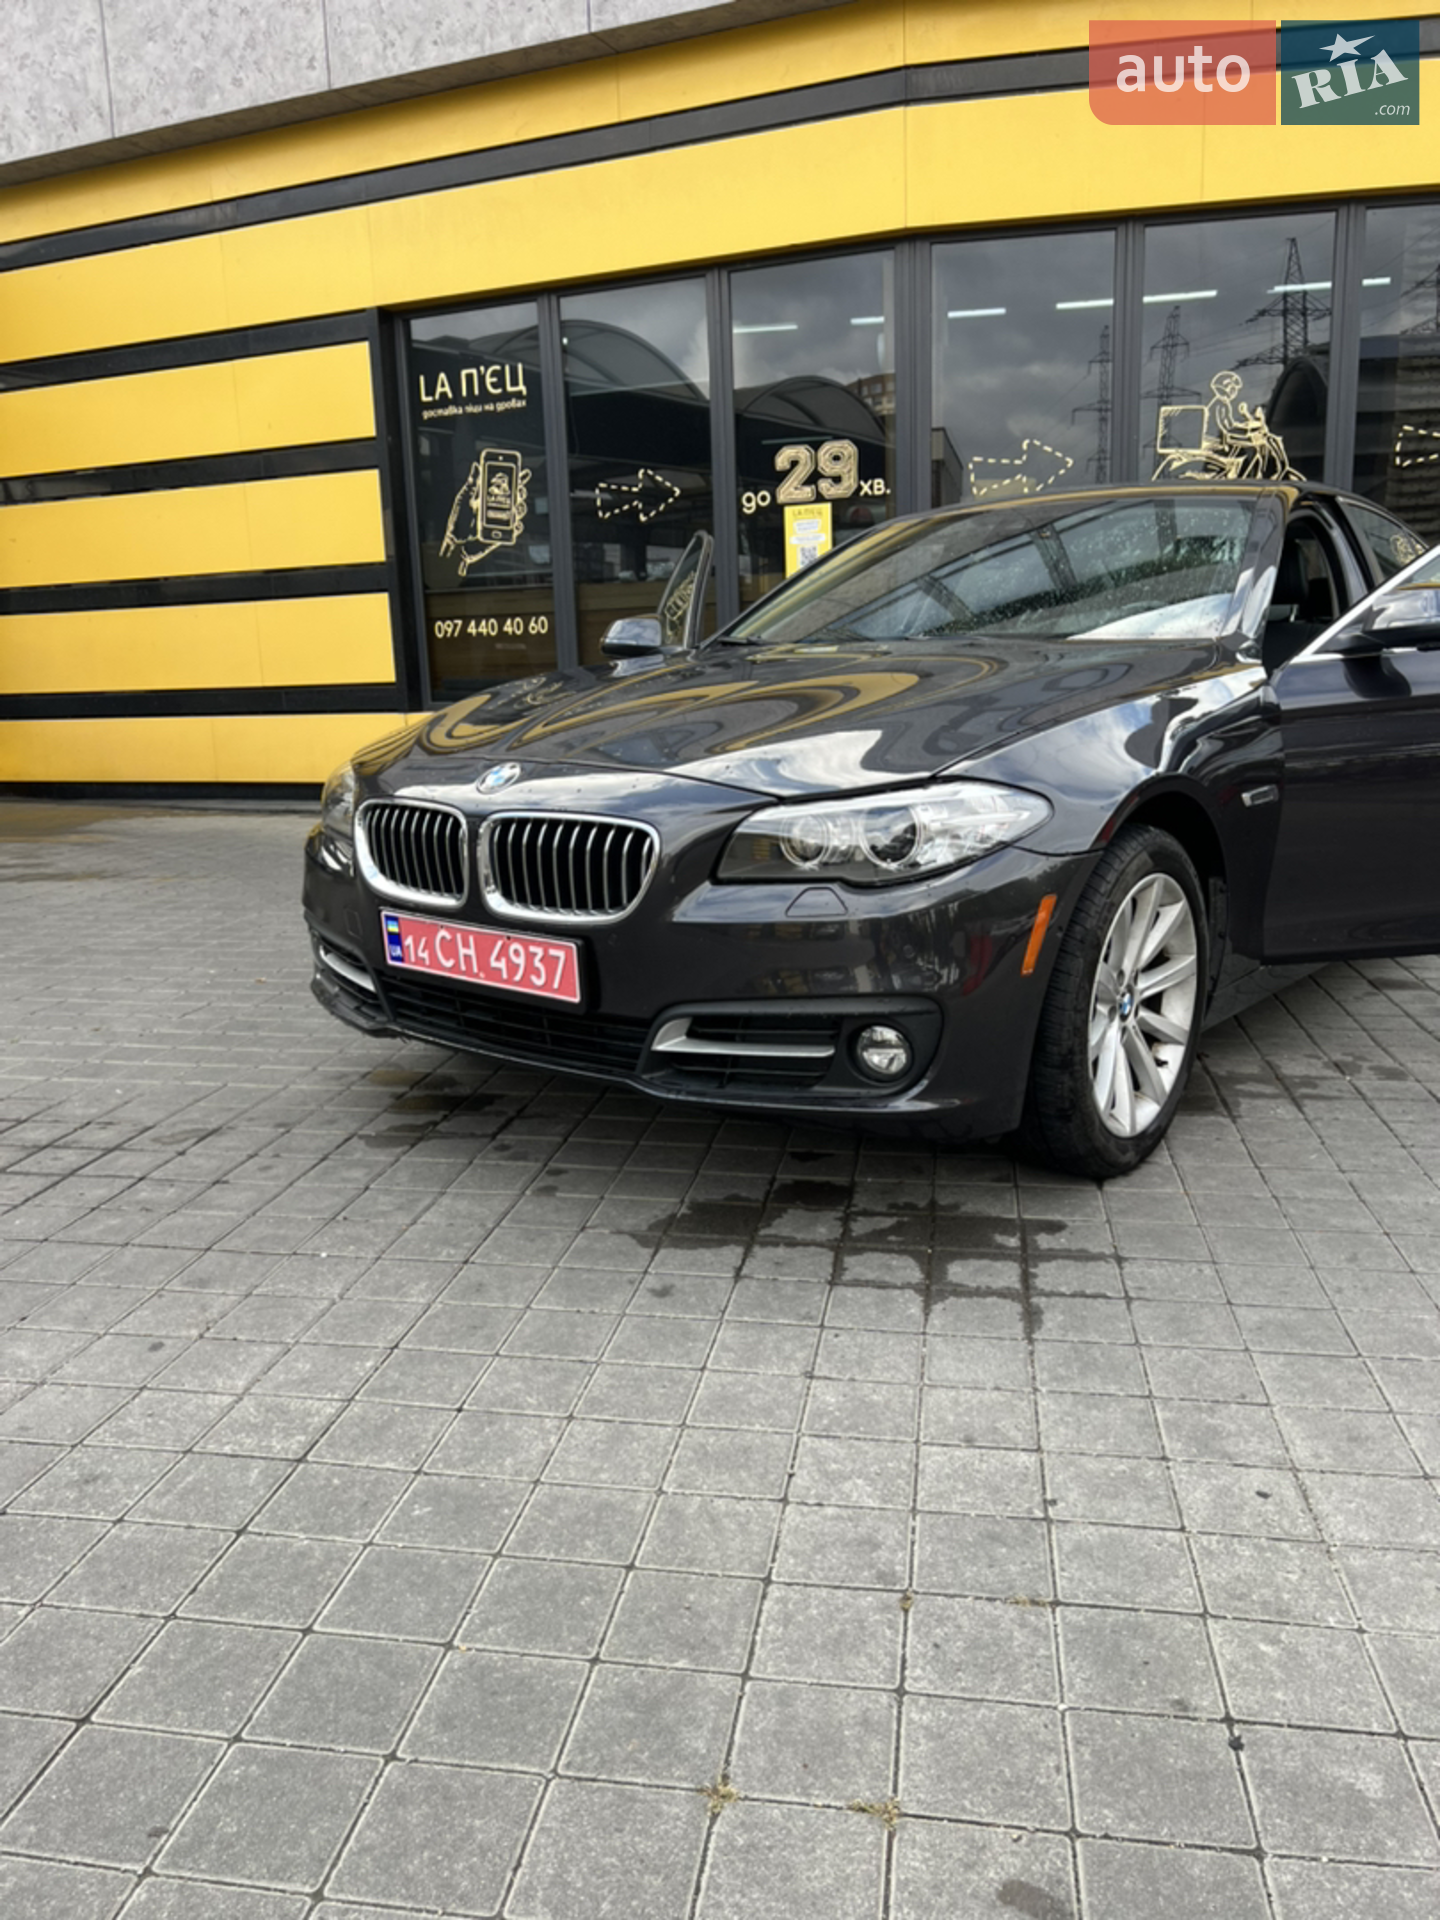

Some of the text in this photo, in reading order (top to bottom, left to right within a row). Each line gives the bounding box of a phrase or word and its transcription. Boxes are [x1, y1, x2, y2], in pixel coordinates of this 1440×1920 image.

[419, 362, 527, 402] LA П'ЄЦ
[774, 439, 859, 504] 29
[434, 615, 549, 639] 097 440 40 60
[489, 938, 567, 990] 4937
